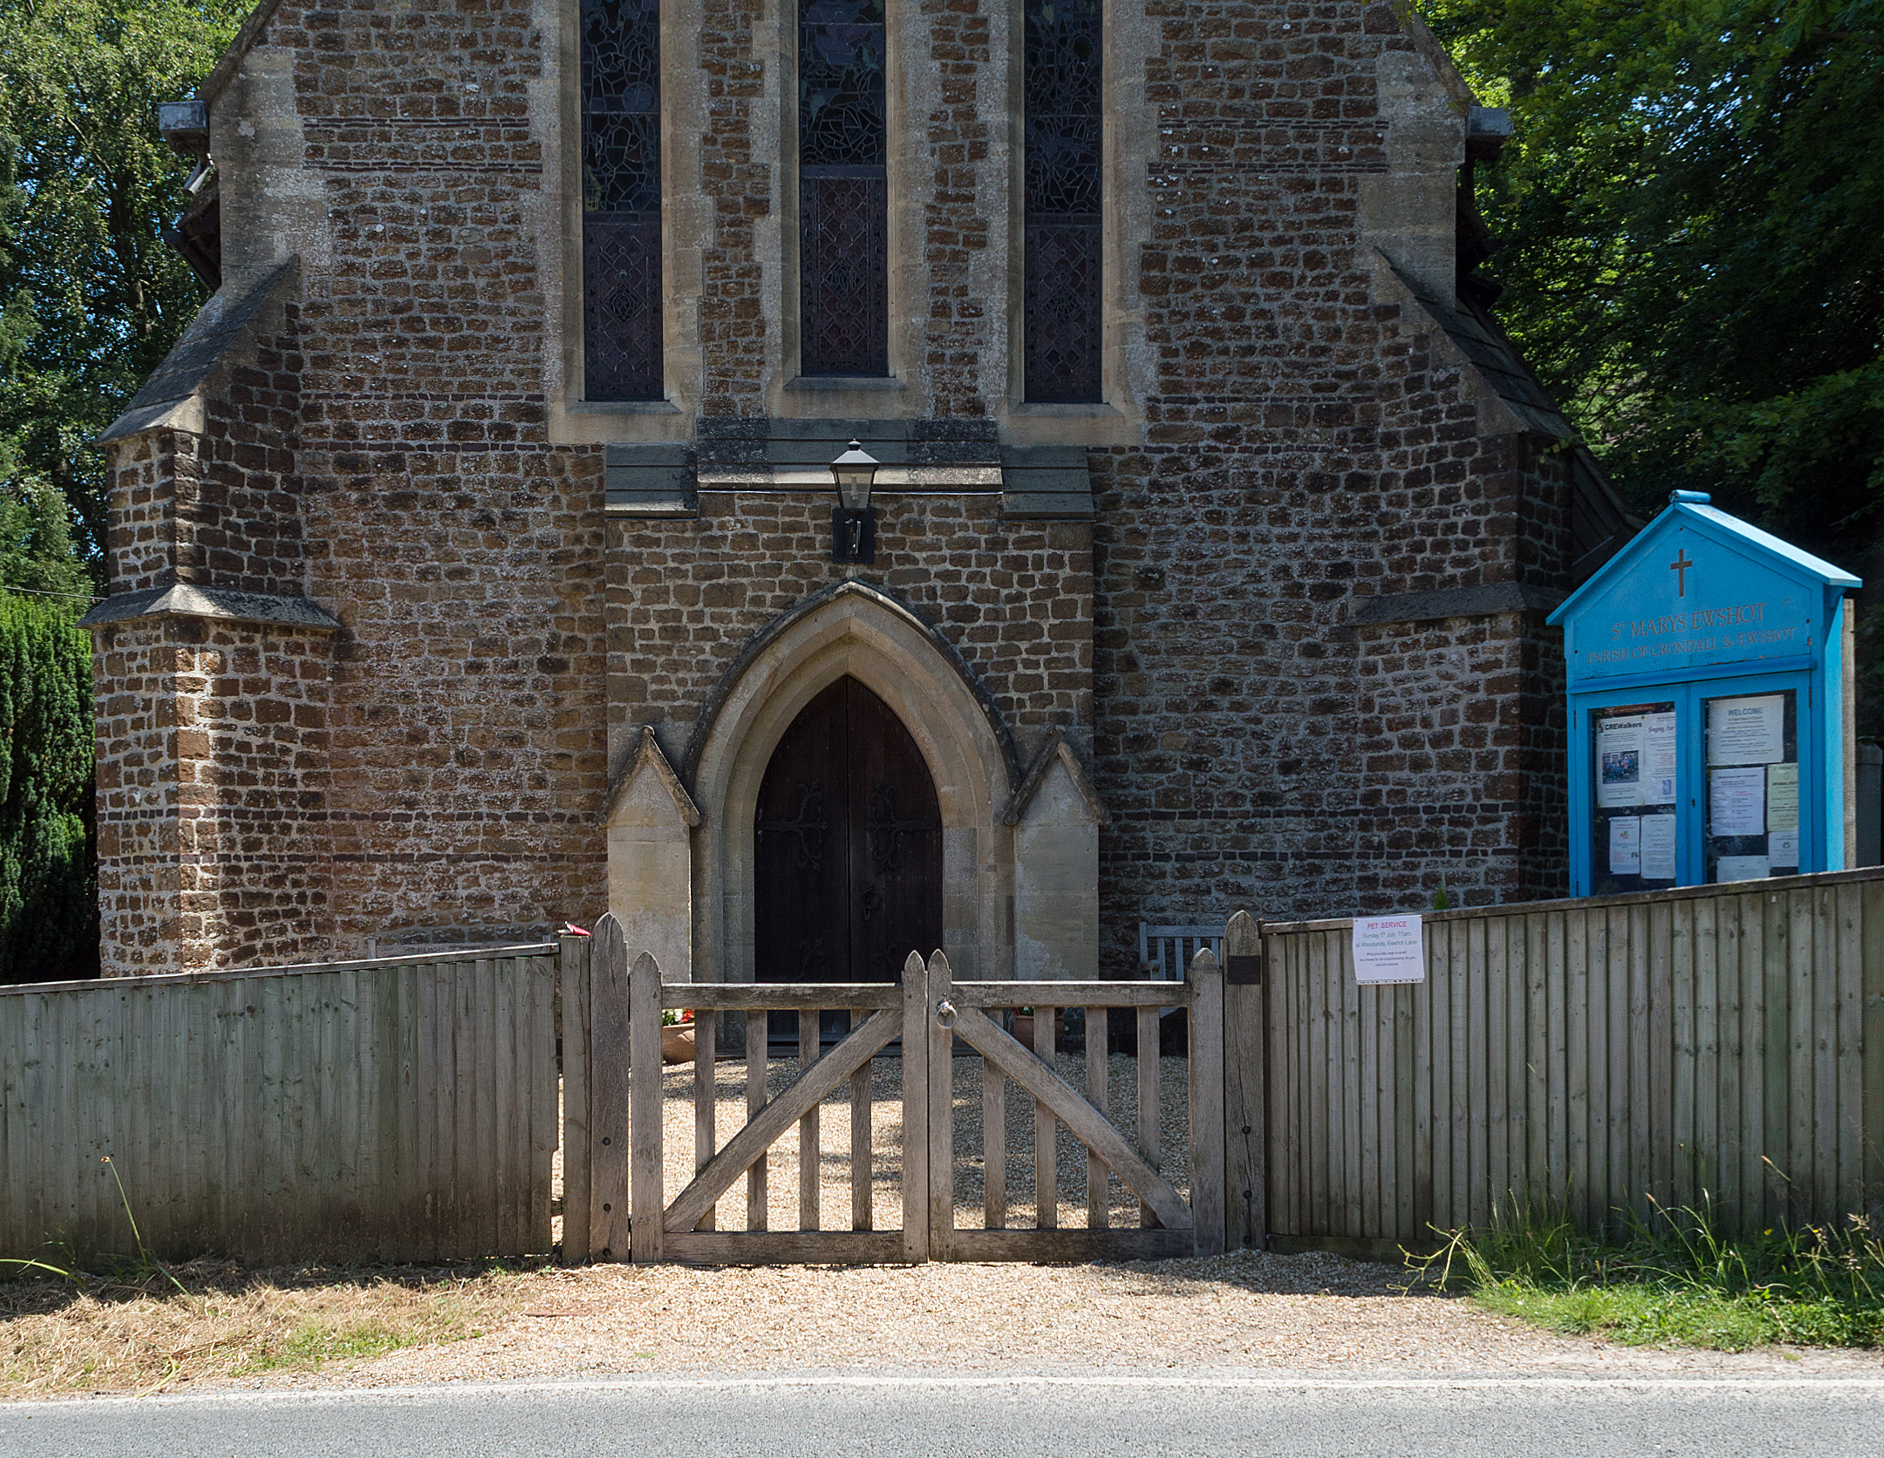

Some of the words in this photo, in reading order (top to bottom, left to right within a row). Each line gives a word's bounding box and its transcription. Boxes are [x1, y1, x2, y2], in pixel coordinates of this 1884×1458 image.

[1630, 614, 1686, 638] MARYS
[1691, 603, 1766, 630] EWSHOT
[1588, 647, 1629, 664] PARISH
[1632, 645, 1648, 659] OF
[1650, 637, 1718, 657] CRONDALL
[1722, 635, 1733, 648] &
[1737, 627, 1795, 646] EWSHOT
[1728, 707, 1763, 716] WELCOME
[1604, 722, 1642, 730] CREWalkers
[1381, 921, 1407, 929] SERVICE
